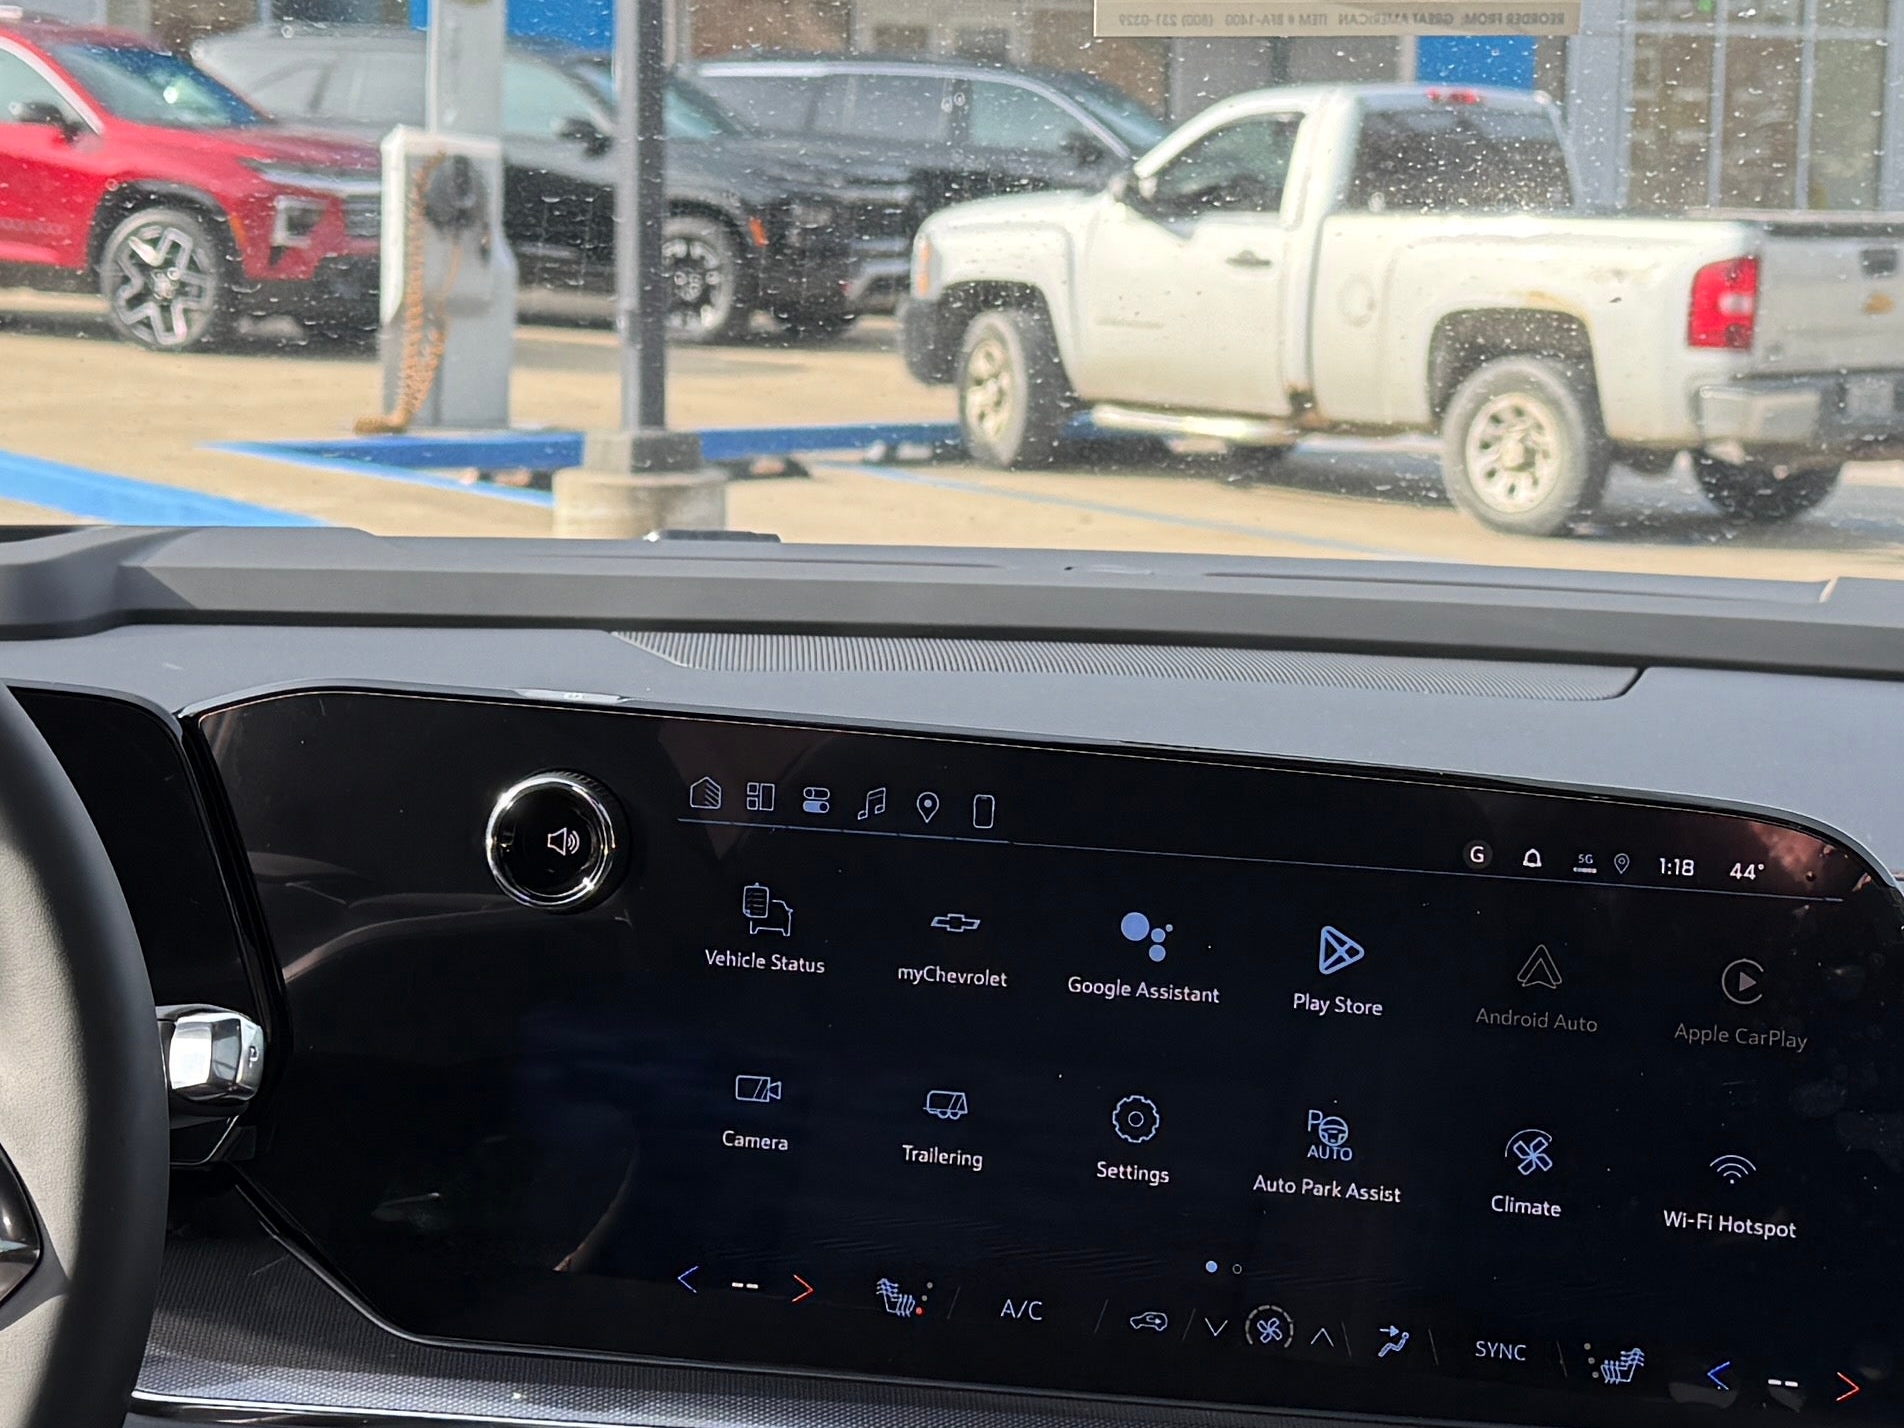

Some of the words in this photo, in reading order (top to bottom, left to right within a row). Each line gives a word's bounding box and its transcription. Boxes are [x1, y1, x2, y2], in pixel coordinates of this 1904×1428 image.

[1469, 845, 1485, 864] G
[1578, 853, 1594, 865] 5G
[1659, 857, 1695, 877] 1:18
[1729, 862, 1765, 881] 44°
[705, 948, 766, 970] Vehicle
[770, 953, 826, 974] Status
[897, 964, 1008, 988] myChevrolet
[1067, 975, 1132, 1001] Google
[1135, 981, 1221, 1004] Assistant
[1292, 992, 1331, 1017] Play
[1334, 996, 1383, 1016] Store
[1475, 1007, 1549, 1029] Android
[1553, 1013, 1598, 1033] Auto
[1674, 1022, 1730, 1046] Apple
[1734, 1028, 1808, 1054] CarPlay
[721, 1129, 789, 1152] Camera
[902, 1143, 984, 1172] Trailering
[1306, 1145, 1353, 1162] AUTO
[1095, 1160, 1170, 1187] Settings
[1252, 1173, 1296, 1194] Auto
[1301, 1178, 1342, 1198] Park
[1345, 1182, 1401, 1204] Assist
[1491, 1194, 1562, 1218] Climate
[1663, 1210, 1713, 1232] Wi-Fi
[1718, 1215, 1797, 1241] Hotspot
[1000, 1298, 1044, 1322] A/C
[1474, 1340, 1527, 1361] SYNC
